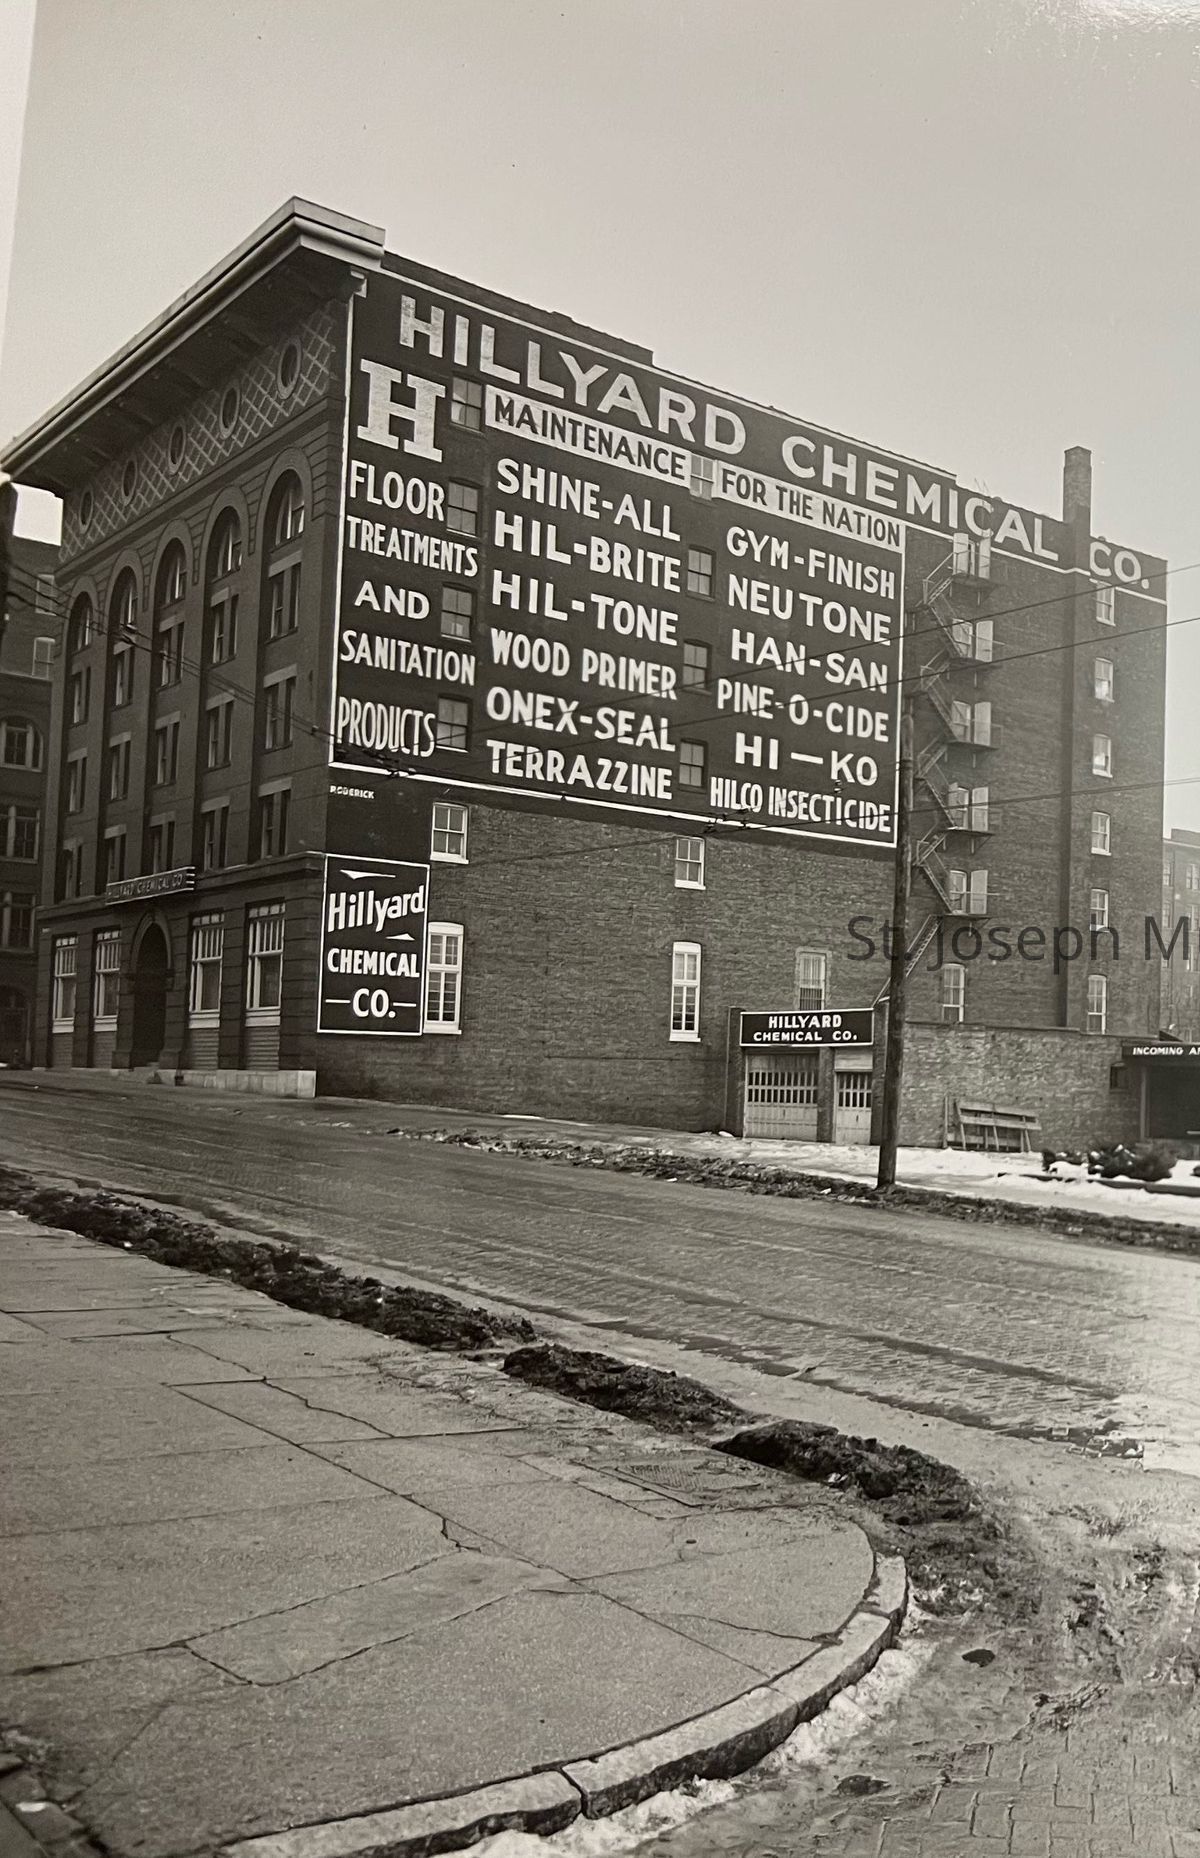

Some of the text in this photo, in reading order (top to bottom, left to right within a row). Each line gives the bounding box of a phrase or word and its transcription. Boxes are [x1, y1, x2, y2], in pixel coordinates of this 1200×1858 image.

[356, 358, 446, 464] H
[399, 294, 1150, 588] HILLYARD CHEMICAL CO.
[348, 459, 446, 522] FLOOR
[493, 394, 901, 548] MAINTENANCE FOR THE NATION
[497, 457, 682, 542] SHINE-ALL
[346, 515, 479, 577] TREATMENTS
[495, 509, 682, 594] HIL-BRITE
[726, 526, 896, 600] GYM-FINISH
[354, 580, 430, 620] AND
[491, 569, 678, 647] HIL-TONE
[728, 573, 892, 647] NEUTONE
[340, 629, 476, 687] SANITATION
[490, 627, 678, 701] WOOD PRIMER
[730, 628, 889, 695] HAN-SAN
[336, 696, 436, 759] PRODUCTS
[486, 686, 677, 752] ONEX-SEAL
[716, 678, 890, 743] PINE-O-CIDE
[330, 785, 375, 799] RODERICK
[486, 738, 673, 800] TERRAZZINE
[710, 776, 892, 833] HILCO INSECTICIDE
[328, 885, 424, 932] Hillyard
[326, 947, 420, 978] CHEMICAL
[352, 988, 396, 1018] CO.
[768, 1014, 842, 1028] HILLYARD
[753, 1030, 858, 1041] CHEMICAL CO.
[1132, 1047, 1184, 1056] INCOMING
